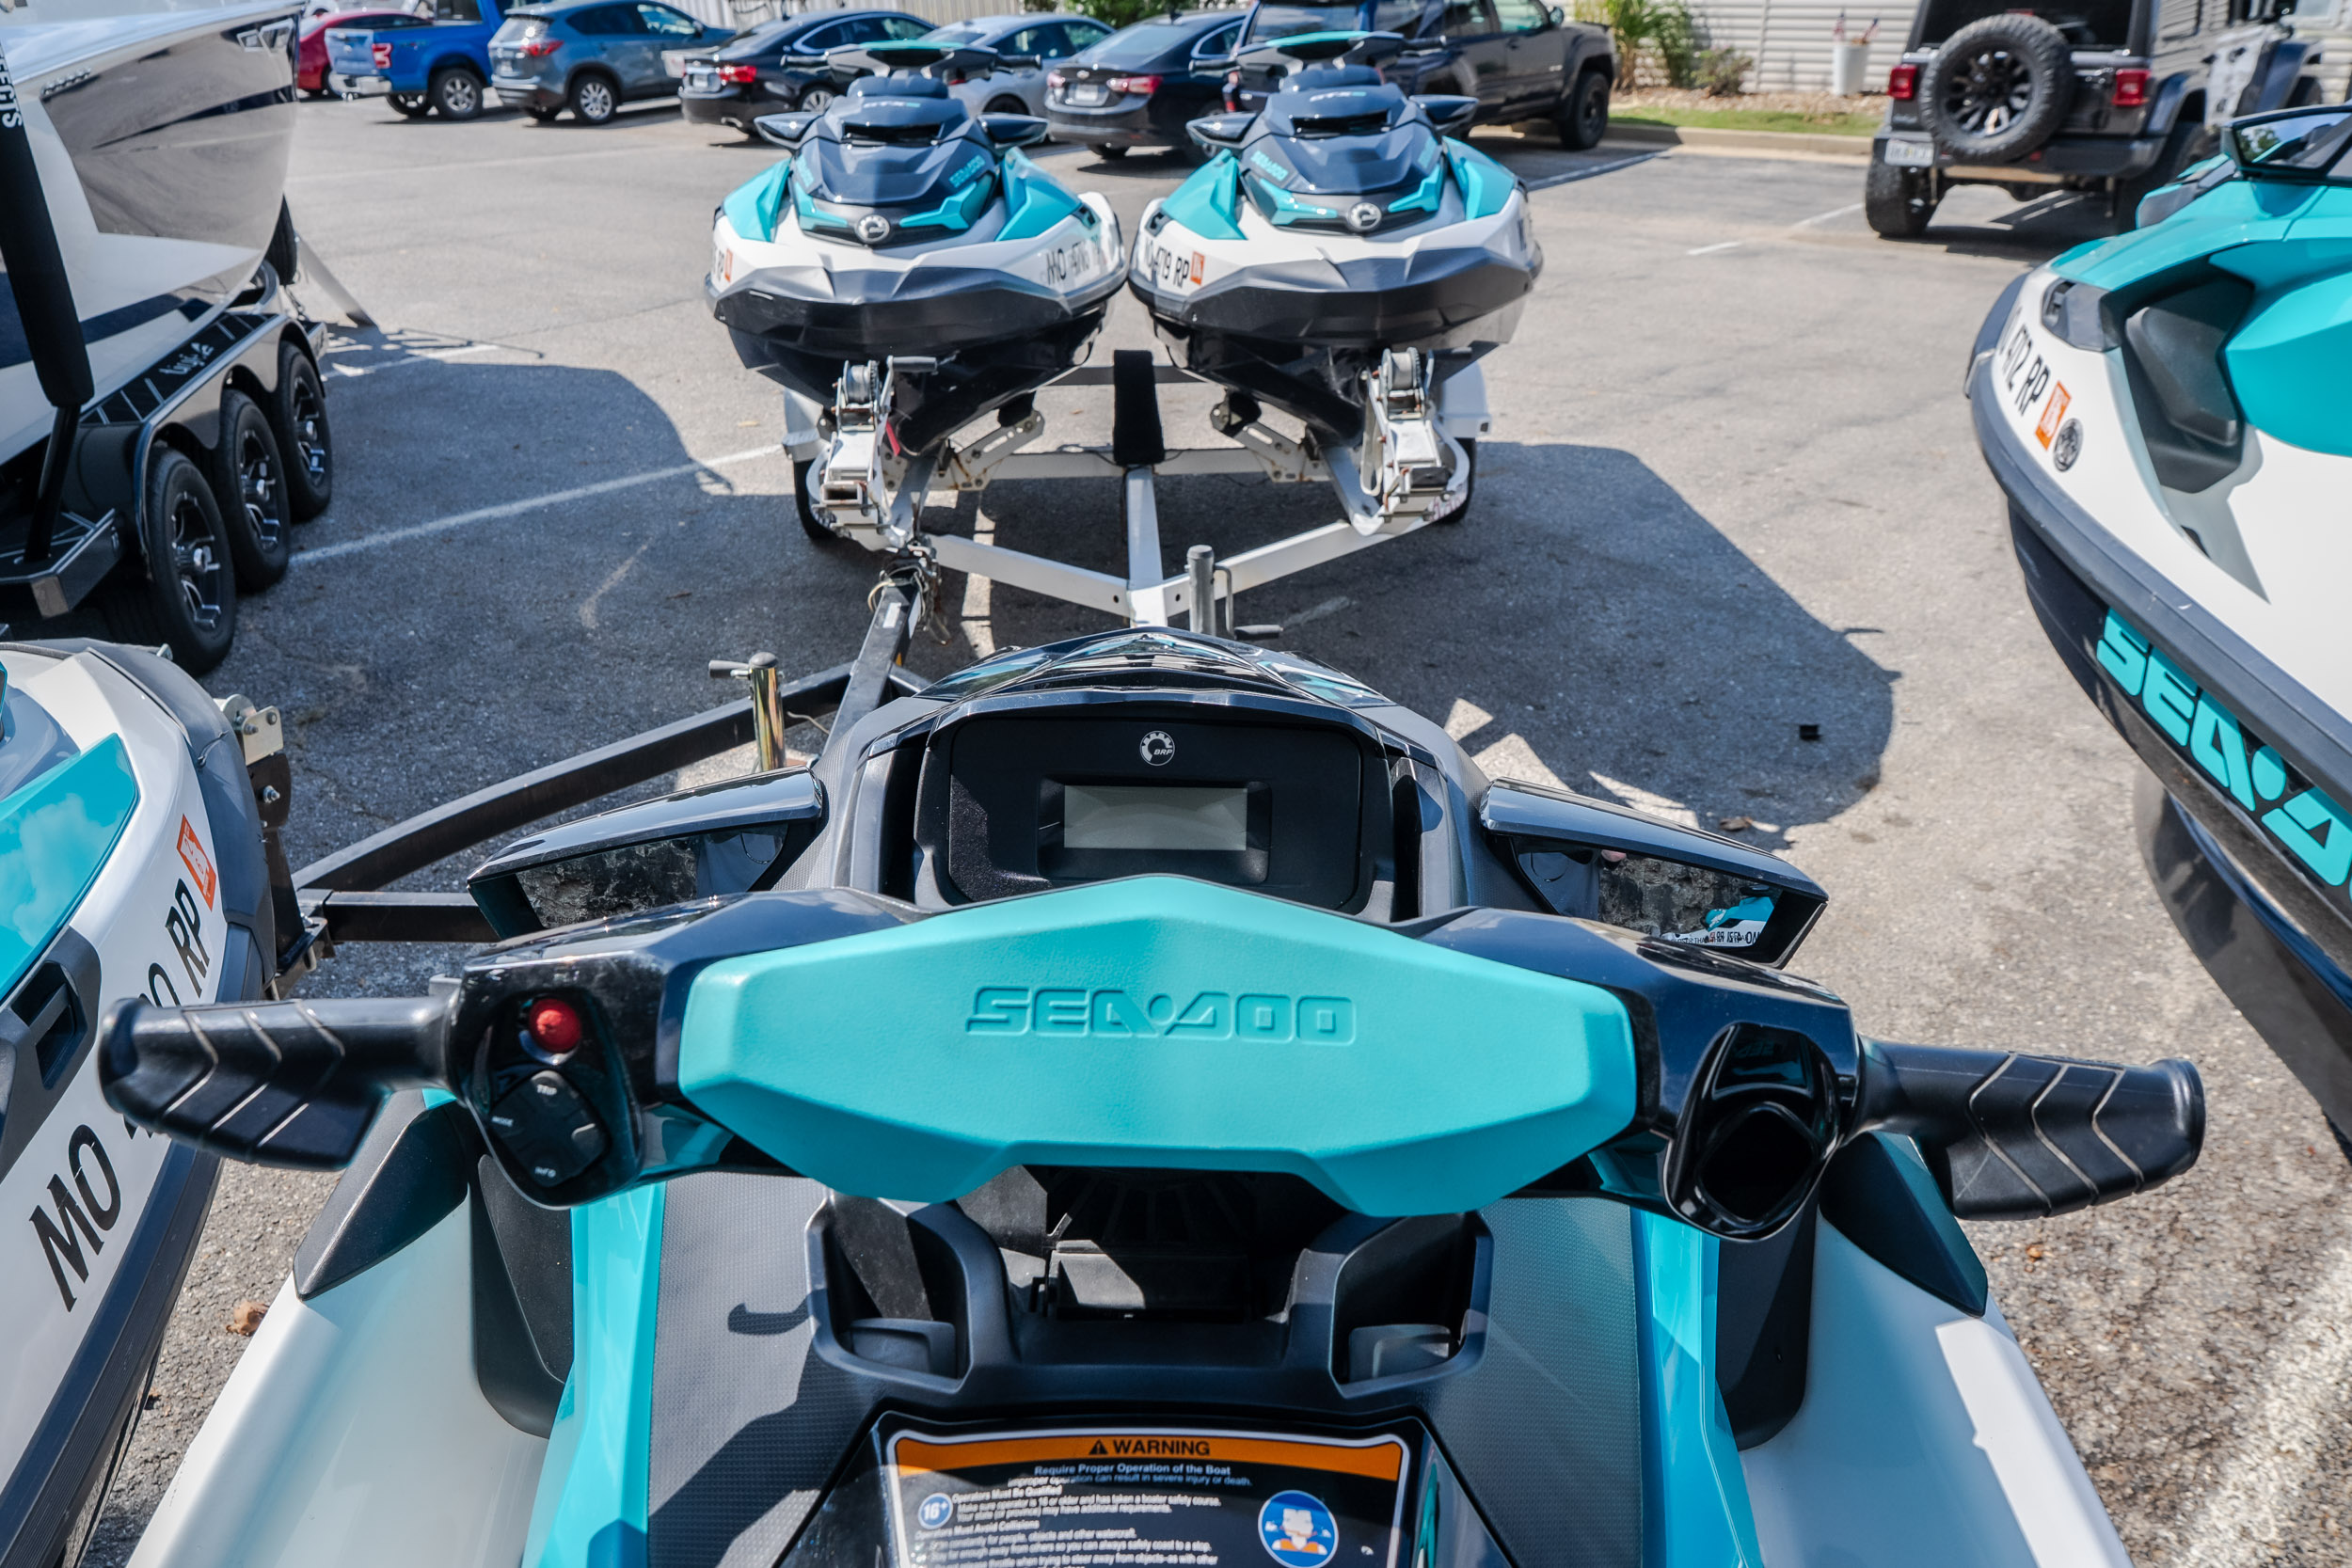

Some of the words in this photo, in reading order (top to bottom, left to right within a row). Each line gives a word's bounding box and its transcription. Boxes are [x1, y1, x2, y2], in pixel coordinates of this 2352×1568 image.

[165, 878, 212, 998] RP
[28, 1124, 121, 1312] MO
[1112, 1439, 1211, 1456] WARNING
[1034, 1465, 1076, 1476] Require
[1078, 1464, 1115, 1474] Proper
[1117, 1463, 1170, 1474] Operation
[1172, 1463, 1184, 1474] of
[1185, 1464, 1203, 1475] the
[1205, 1465, 1231, 1476] Boat
[1095, 1474, 1112, 1483] can
[1114, 1473, 1140, 1482] result
[1141, 1473, 1151, 1482] in
[1152, 1474, 1184, 1483] severe
[1185, 1474, 1210, 1486] injury
[1212, 1476, 1222, 1484] or
